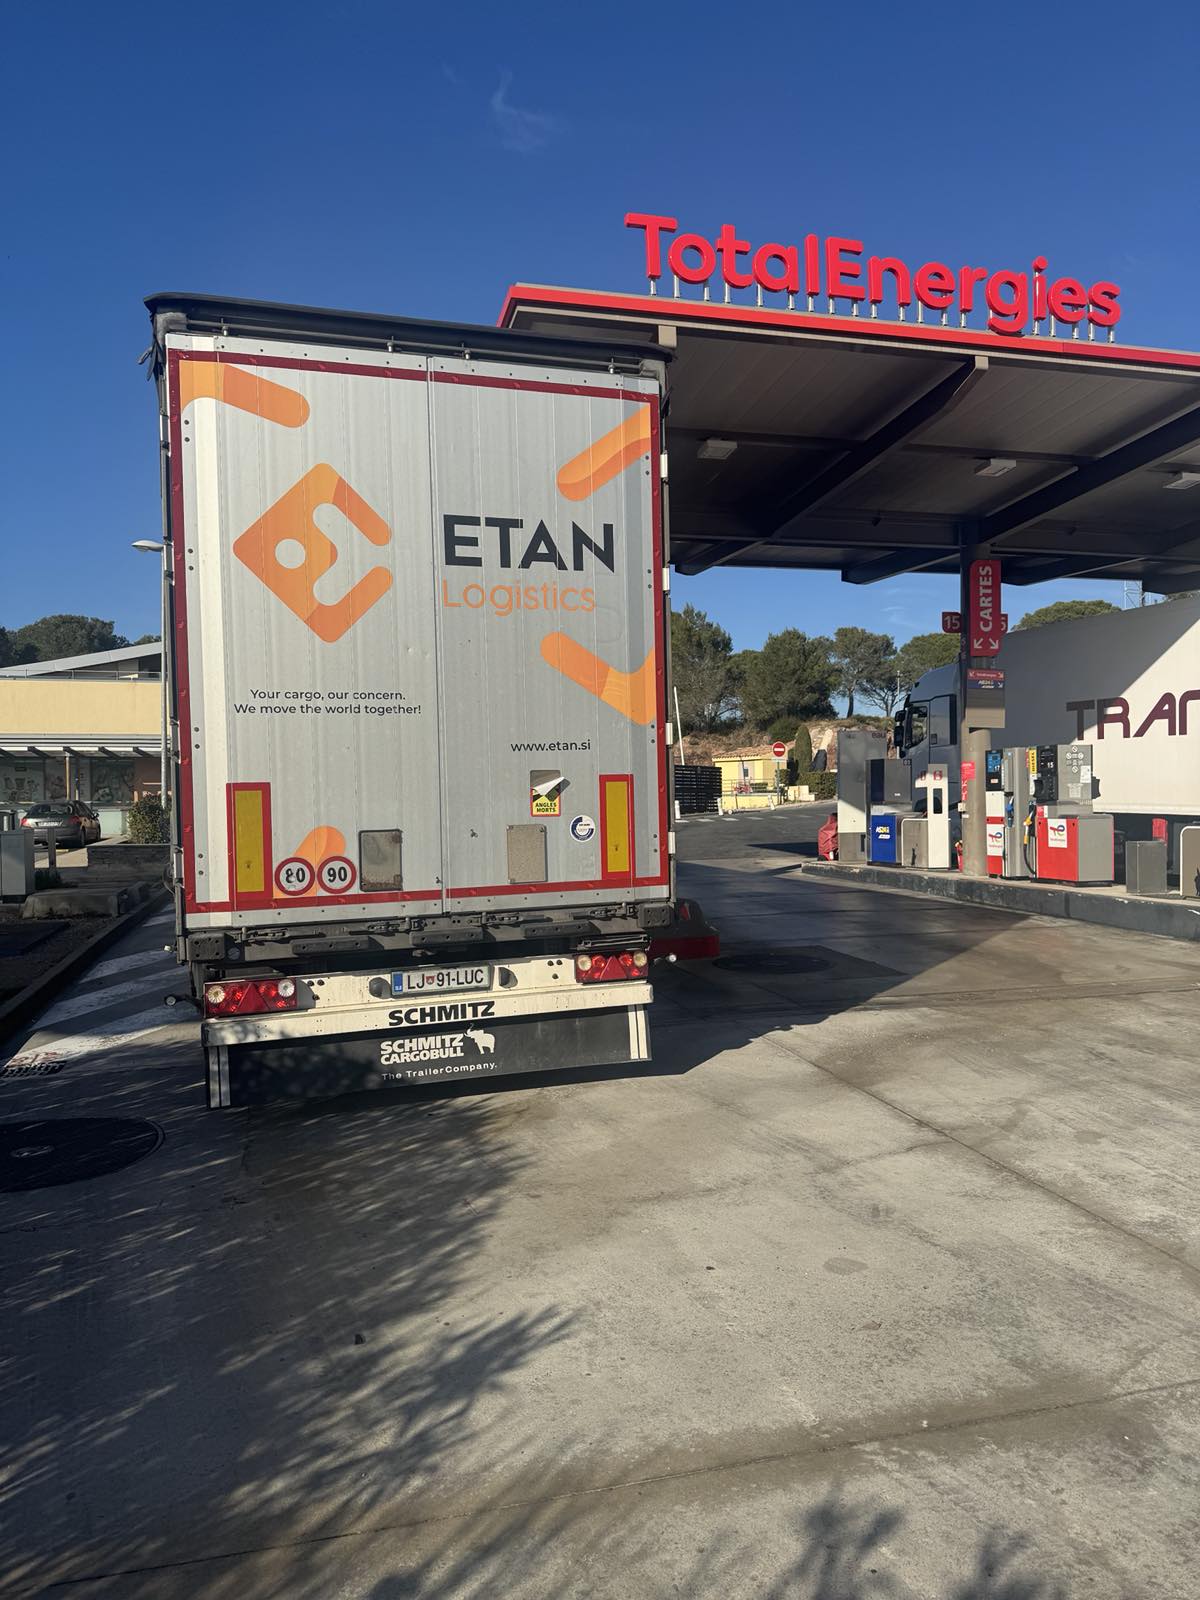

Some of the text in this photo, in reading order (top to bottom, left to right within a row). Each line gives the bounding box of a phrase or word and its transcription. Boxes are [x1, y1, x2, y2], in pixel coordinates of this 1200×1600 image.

[624, 212, 1122, 335] TotalEnergies
[443, 514, 615, 573] ETAN
[442, 577, 595, 617] Logistics
[979, 565, 992, 632] CARTES
[943, 615, 960, 630] 15
[249, 689, 406, 702] Your cargo, our concern.
[233, 703, 421, 716] We move the world together!
[510, 739, 591, 752] www.etan.si
[285, 866, 348, 884] 80 90
[407, 969, 484, 990] LJ 91-LUC
[388, 1000, 495, 1026] SCHMITZ
[380, 1033, 464, 1055] SCHMITZ
[380, 1046, 465, 1065] CARGOBULL
[382, 1072, 402, 1081] The
